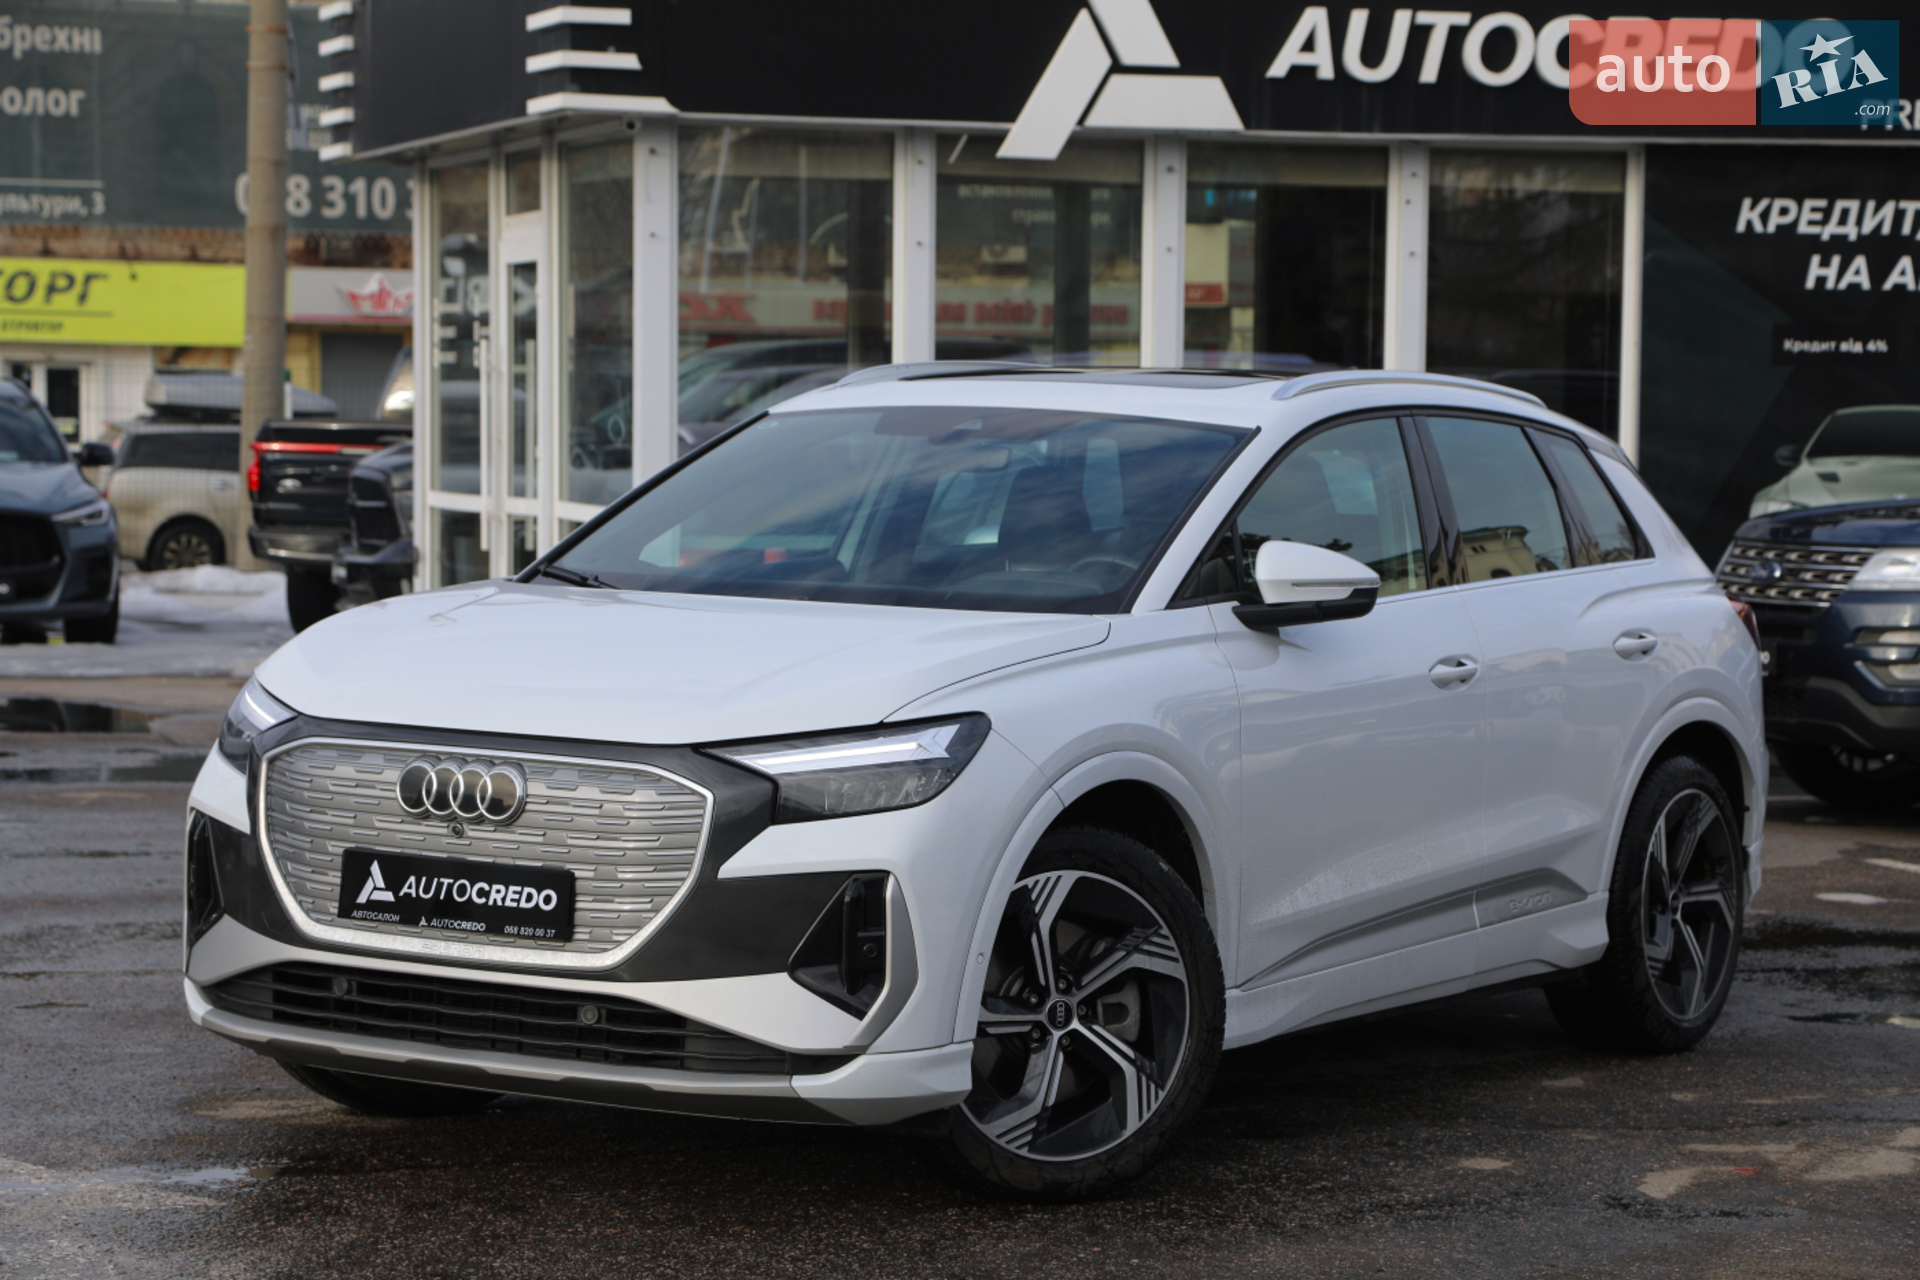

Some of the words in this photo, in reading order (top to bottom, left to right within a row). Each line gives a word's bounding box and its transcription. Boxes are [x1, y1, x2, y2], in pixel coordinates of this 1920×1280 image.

[1266, 5, 1856, 93] AUTOCREDO
[0, 85, 87, 118] олог
[320, 174, 397, 220] 310
[1734, 197, 1920, 242] КРЕДИТ
[0, 268, 108, 306] ОРГ
[1804, 254, 1872, 291] НА
[1881, 254, 1920, 291] А
[1783, 338, 1837, 353] Кредит
[398, 874, 558, 912] AUTOCREDO
[351, 909, 400, 923] АВТОСАЛОН
[430, 918, 486, 932] AUTOCREDO
